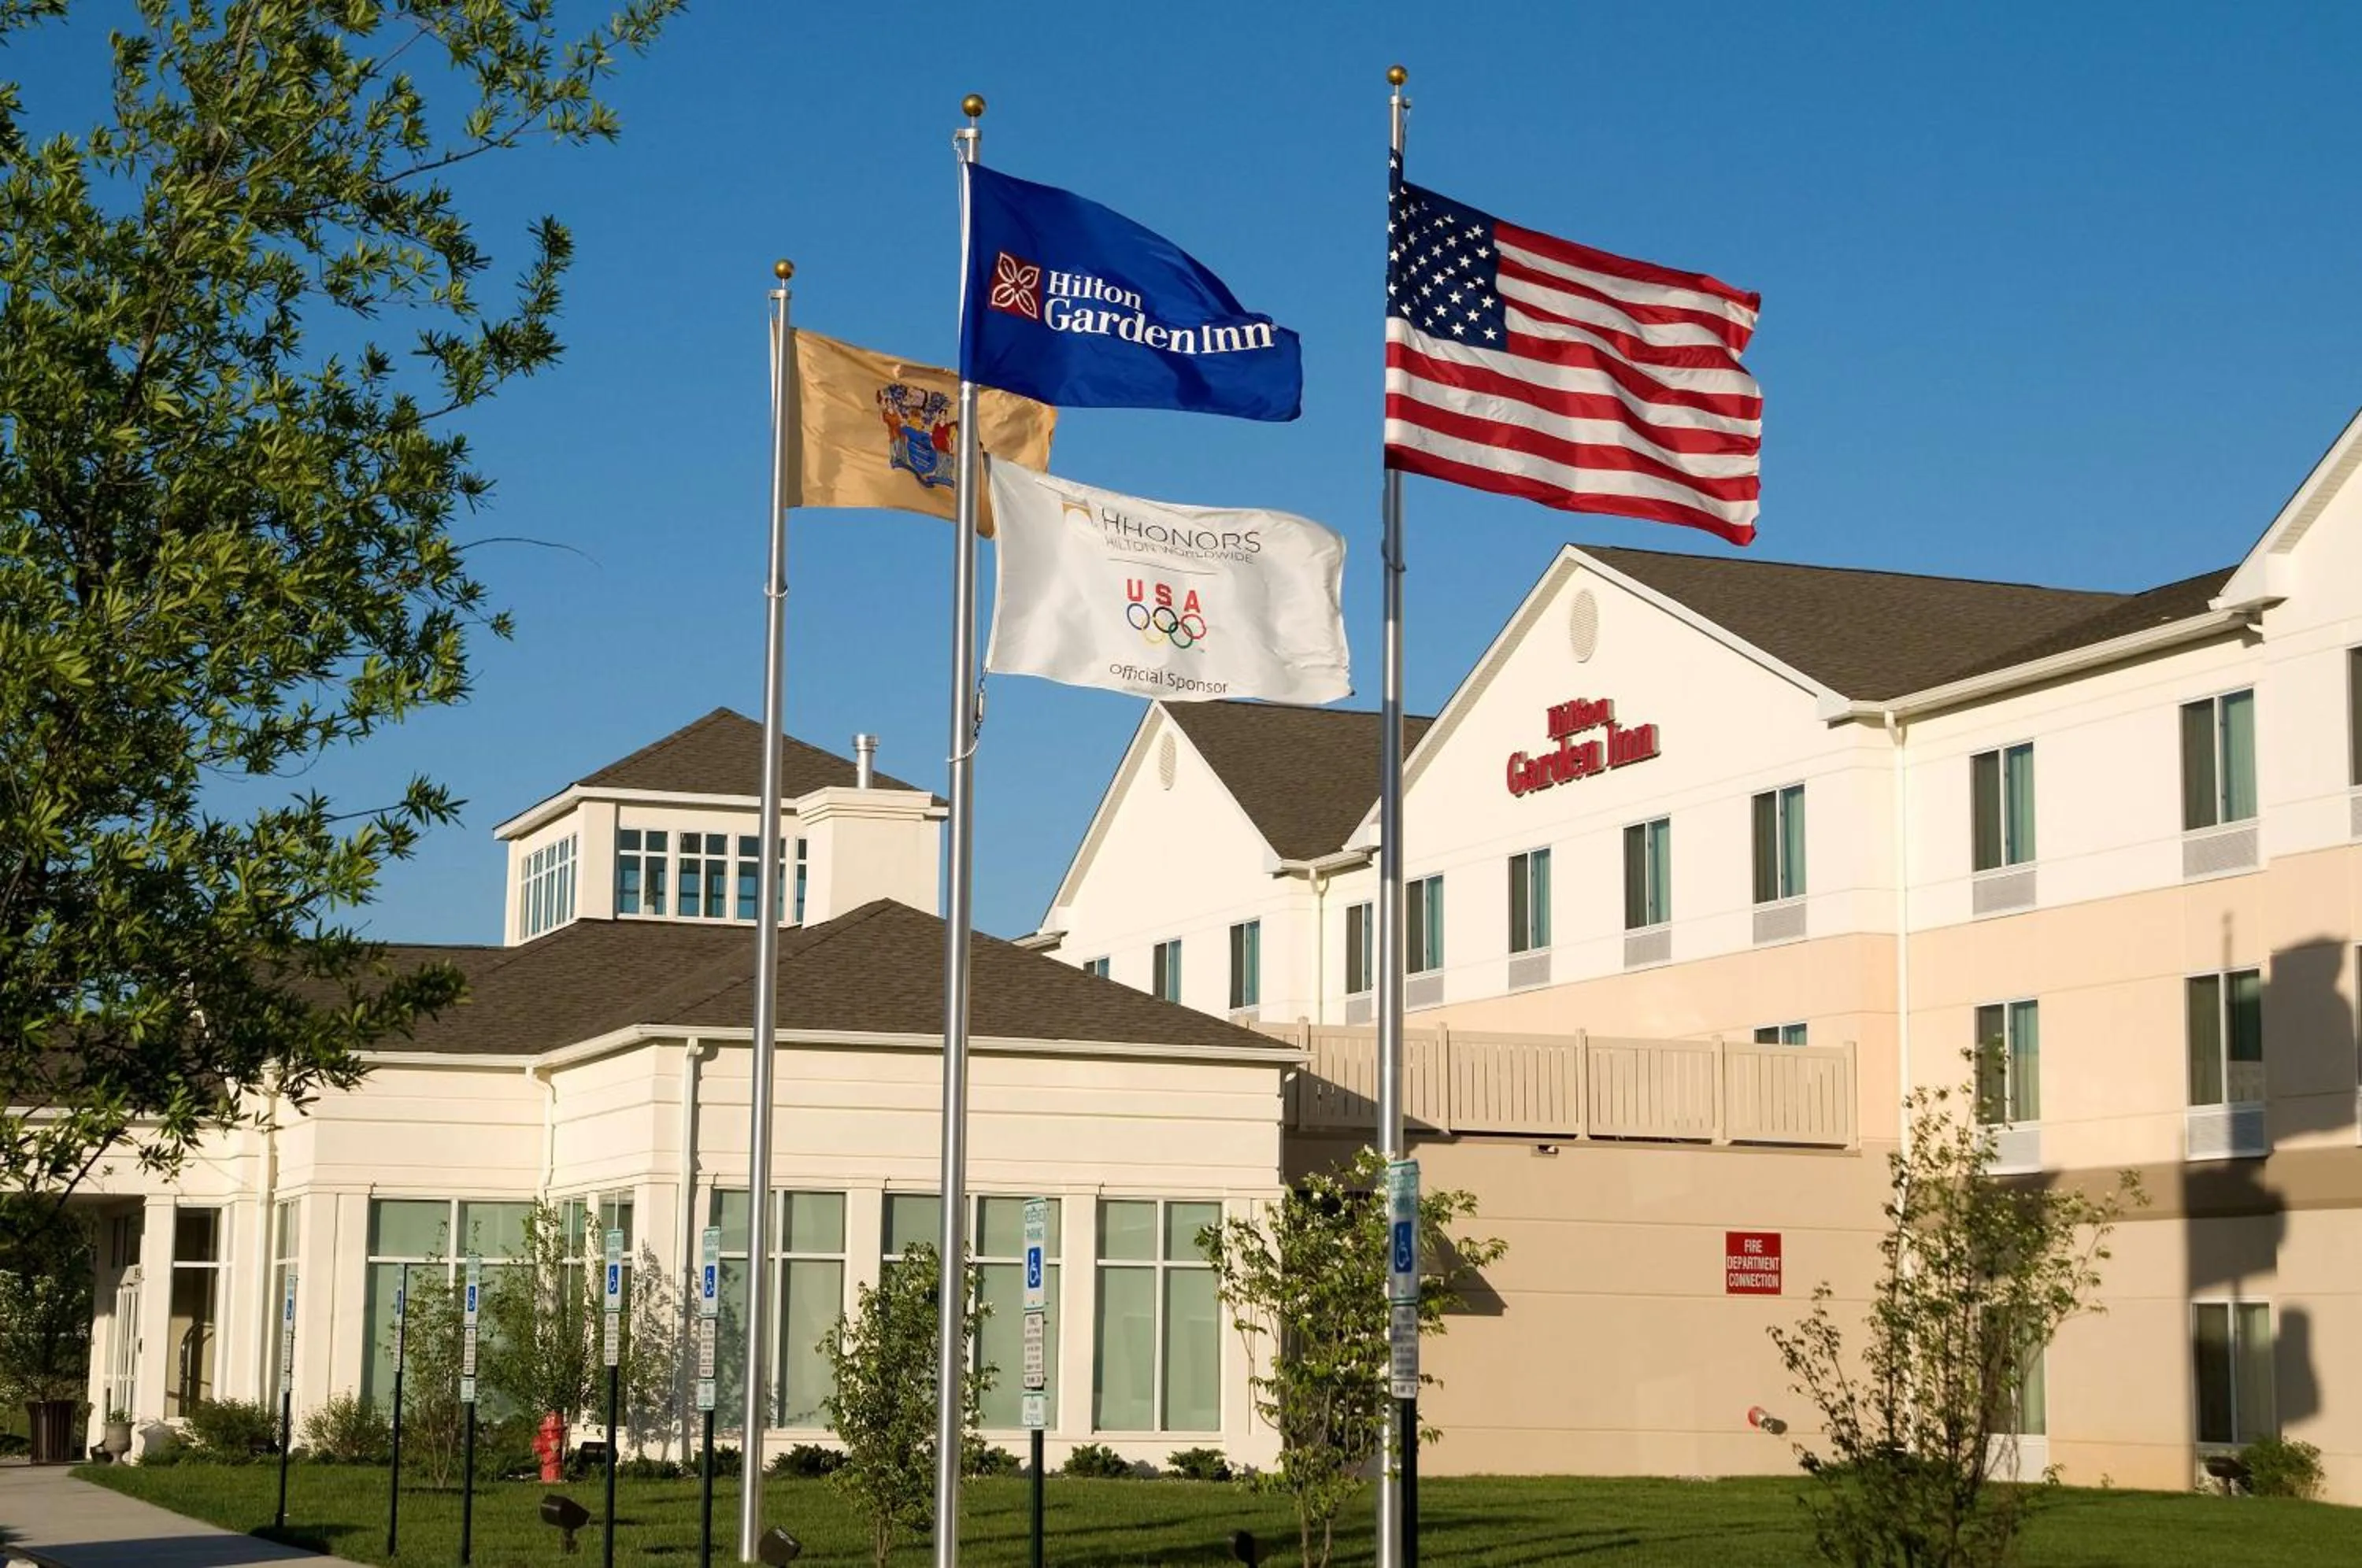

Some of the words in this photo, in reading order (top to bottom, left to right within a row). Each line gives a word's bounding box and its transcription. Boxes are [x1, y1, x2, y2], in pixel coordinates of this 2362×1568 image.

[1047, 270, 1142, 311] Hilton
[1044, 298, 1197, 354] Garden
[1201, 322, 1275, 353] Inn
[1101, 508, 1261, 553] HHONORS
[1127, 579, 1201, 613] USA
[1109, 664, 1163, 685] Official
[1168, 673, 1228, 693] Sponsor
[1507, 737, 1605, 797] Garden
[1601, 721, 1660, 771] Inn
[1744, 1238, 1763, 1253] FIRE
[1727, 1256, 1779, 1270] DEPARTMENT
[1728, 1273, 1779, 1288] CONNECTION
